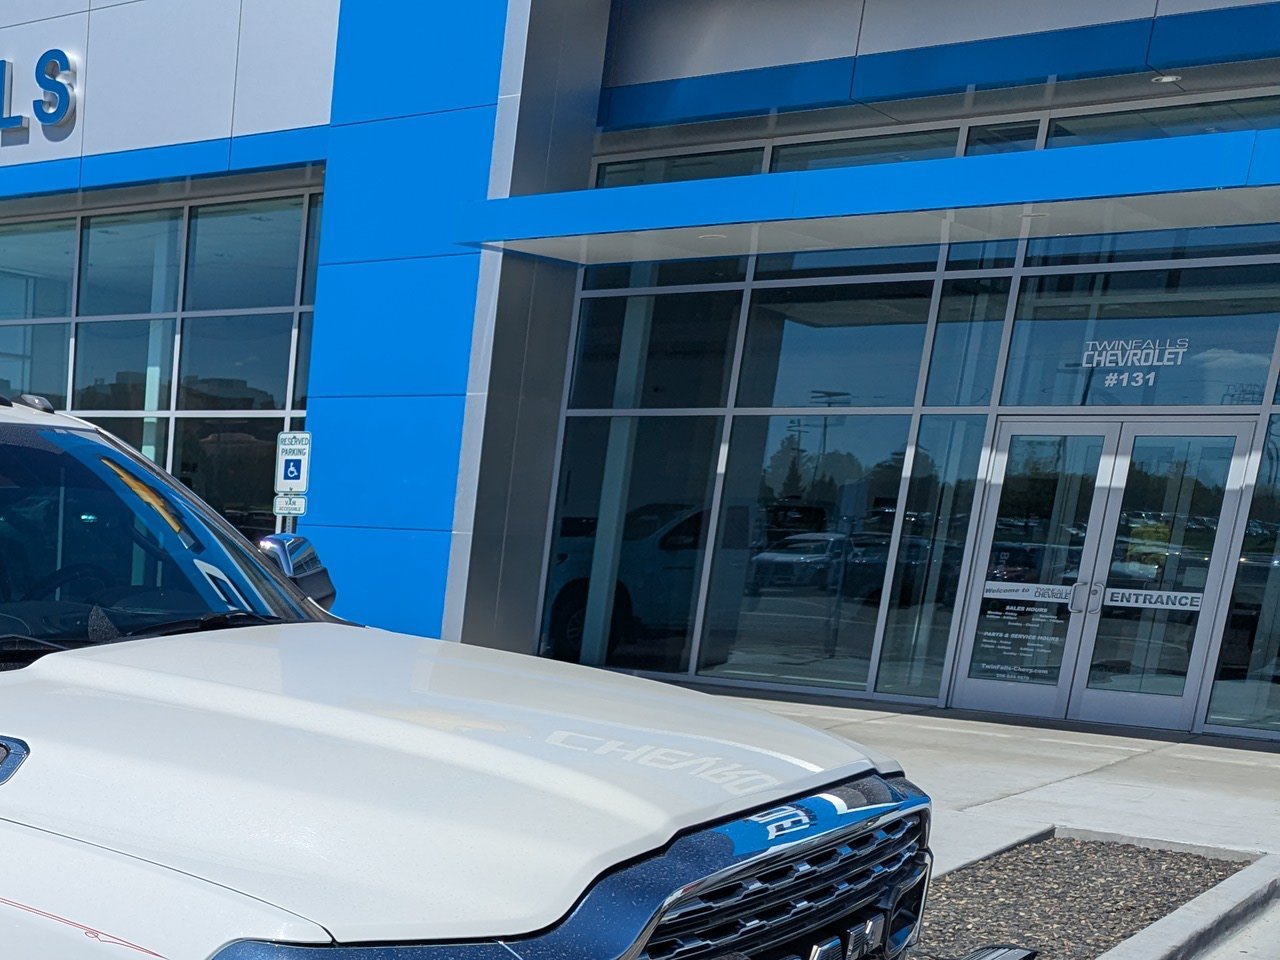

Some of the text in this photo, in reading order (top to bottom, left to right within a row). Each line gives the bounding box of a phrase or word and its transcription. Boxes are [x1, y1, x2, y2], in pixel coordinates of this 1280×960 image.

[1085, 338, 1189, 351] TWINFALLS
[1082, 348, 1188, 368] CHEVROLET
[1104, 371, 1156, 388] #131
[280, 437, 309, 446] RESERVED
[281, 448, 306, 456] PARKING
[1109, 592, 1201, 607] ENTRANCE
